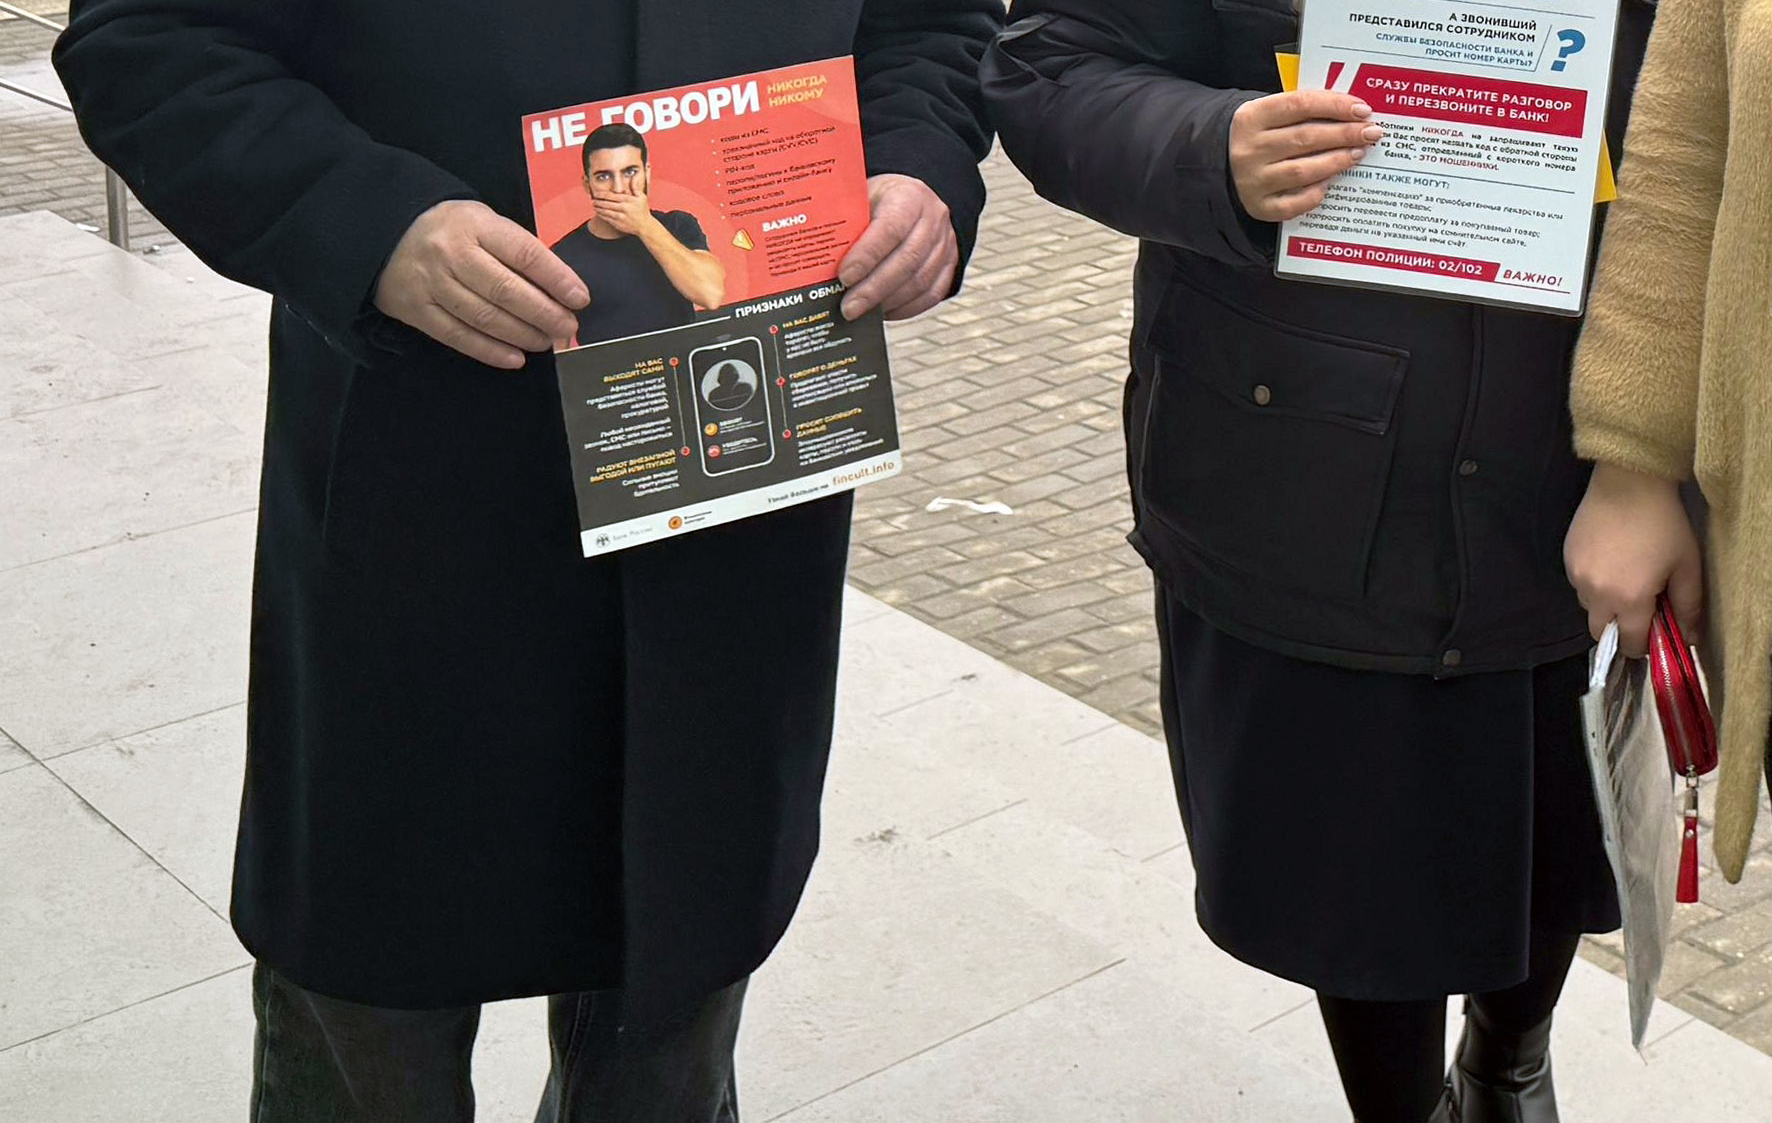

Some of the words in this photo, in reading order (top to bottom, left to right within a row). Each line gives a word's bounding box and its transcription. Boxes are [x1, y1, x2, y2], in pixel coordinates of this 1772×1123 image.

[1349, 13, 1442, 32] ПРЕДСТАВИЛСЯ
[1446, 24, 1535, 42] СОТРУДНИКОМ
[1448, 13, 1457, 21] А
[1460, 13, 1537, 30] ЗВОНИВШИЙ
[1375, 33, 1416, 43] СЛУЖБЫ
[1419, 37, 1491, 52] БЕЗОПАСНОСТИ
[1494, 46, 1524, 56] БАНКА
[1425, 48, 1460, 58] ПРОСИТ
[1463, 52, 1494, 62] НОМЕР
[1497, 56, 1532, 66] КАРТЫ?
[767, 74, 826, 93] НИКОГДА
[1365, 77, 1409, 91] СРАЗУ
[1413, 82, 1498, 102] ПРЕКРАТИТЕ
[1502, 93, 1572, 111] РАЗГОВОР
[768, 87, 824, 106] НИКОМУ
[1385, 93, 1394, 103] И
[1398, 94, 1493, 115] ПЕРЕЗВОНИТЕ
[1497, 107, 1505, 116] В
[1509, 108, 1549, 122] БАНК!
[531, 111, 589, 151] НЕ
[600, 80, 759, 139] ГОВОРИ
[1375, 173, 1411, 184] ТАКЖЕ
[1414, 178, 1450, 189] МОГУТ:
[762, 214, 806, 232] ВАЖНО
[1299, 242, 1363, 258] ТЕЛЕФОН
[1365, 251, 1435, 269] ПОЛИЦИИ:
[1438, 260, 1483, 275] 02/102
[1503, 270, 1562, 286] ВАЖНО!
[734, 293, 803, 317] ПРИЗНАКИ
[832, 460, 894, 486] fincult.info
